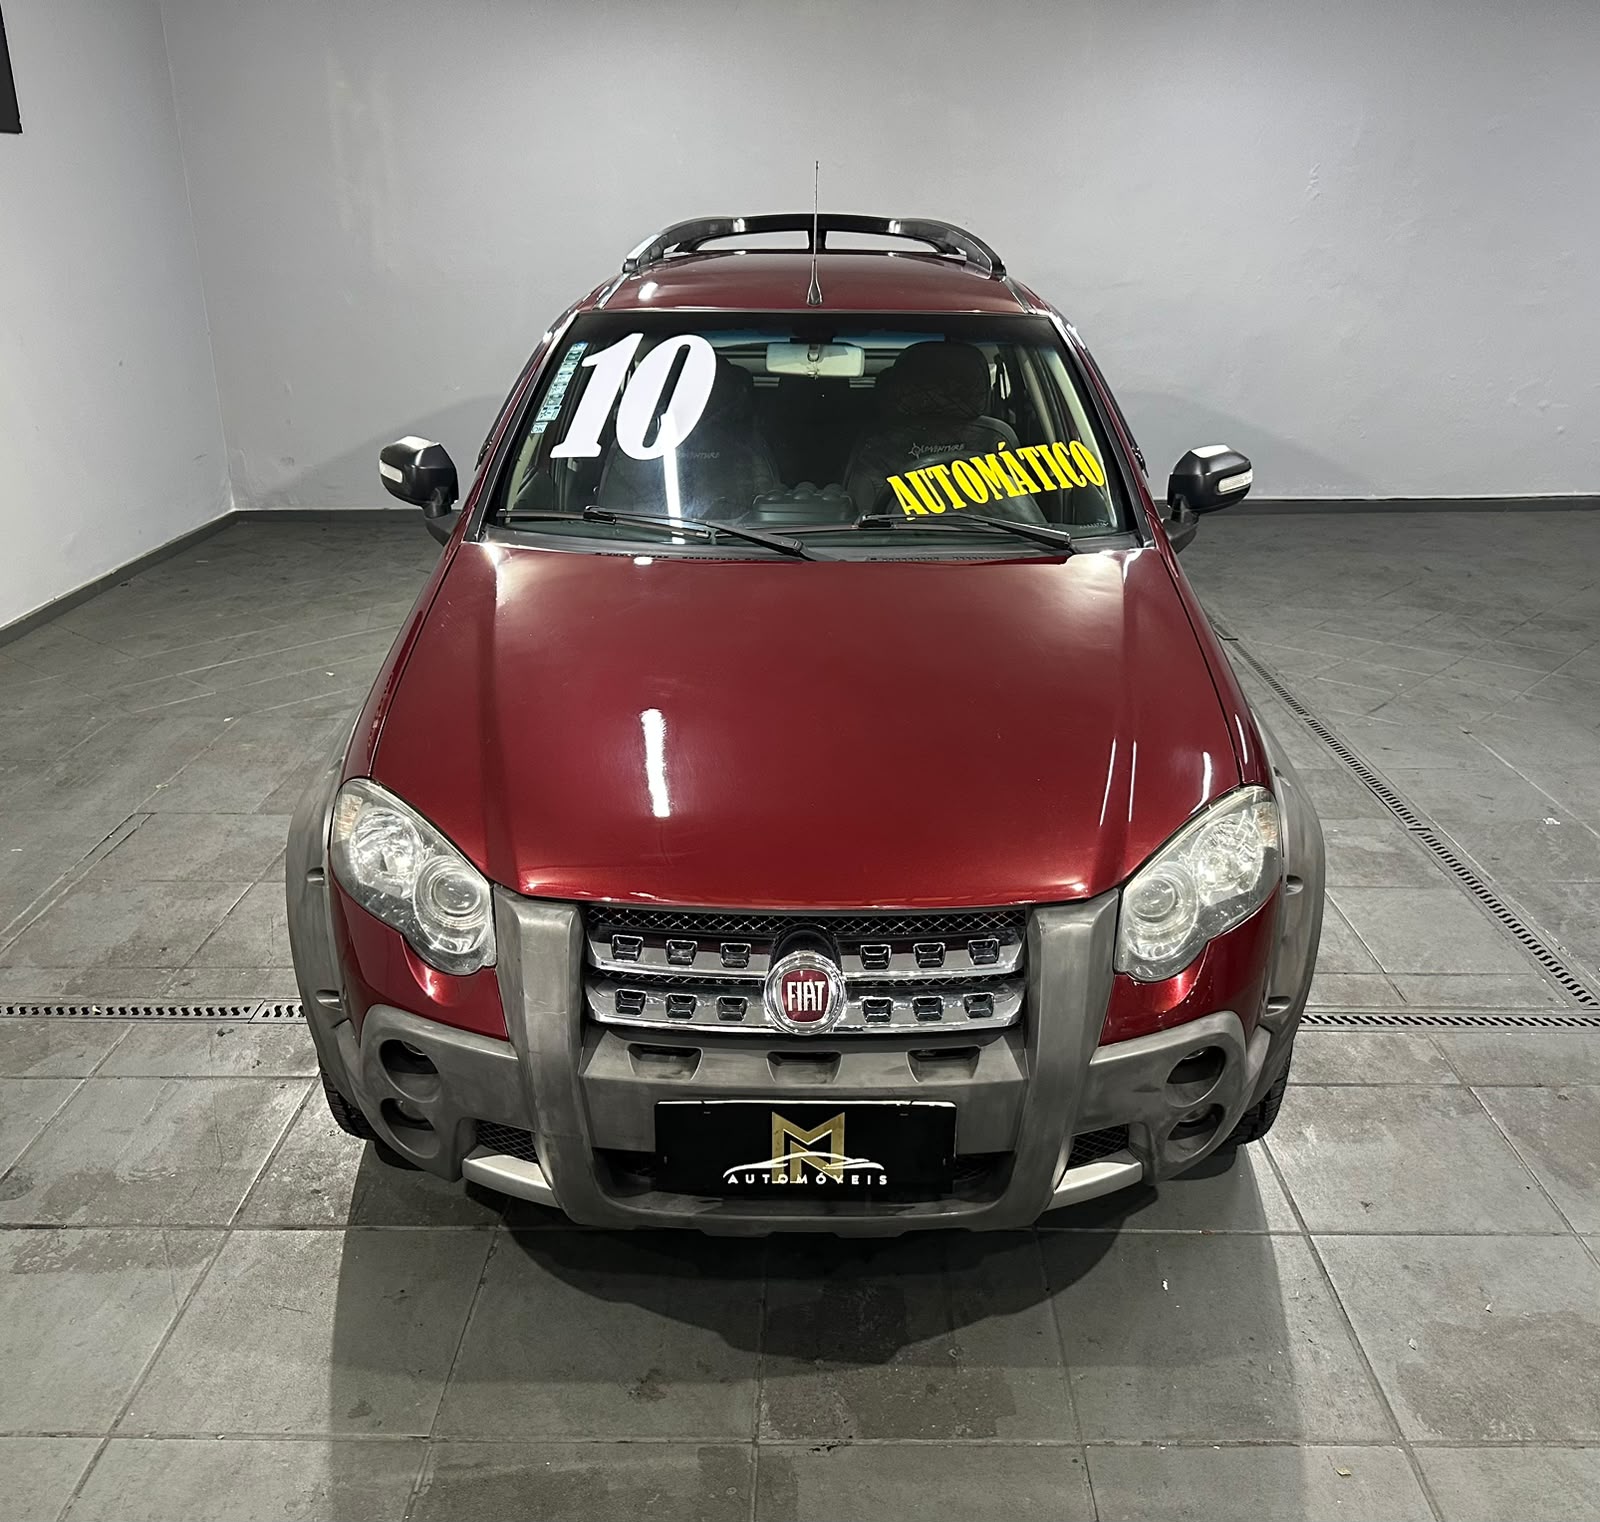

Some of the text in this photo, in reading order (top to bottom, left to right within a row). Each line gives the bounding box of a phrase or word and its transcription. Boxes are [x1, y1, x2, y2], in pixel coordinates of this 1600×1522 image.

[550, 332, 717, 460] 10
[886, 441, 1105, 520] AUTOMÁTICO
[787, 980, 826, 1012] FIAT
[727, 1172, 888, 1185] AUTOMÓVEIS
